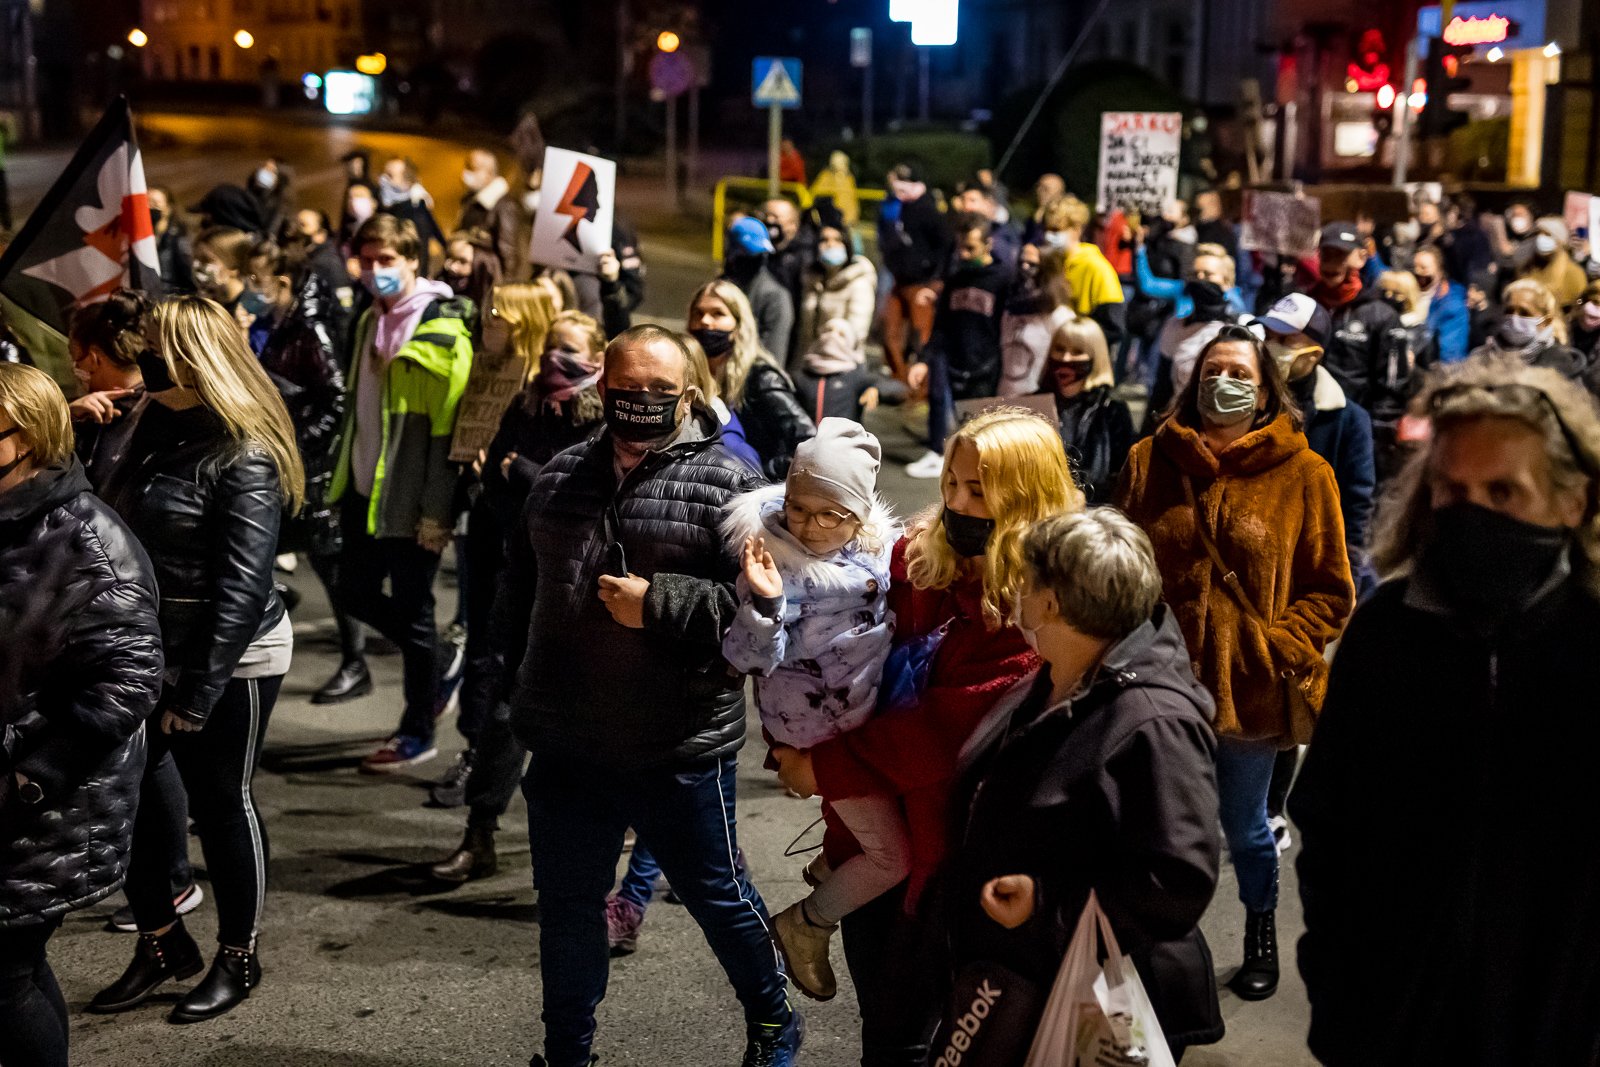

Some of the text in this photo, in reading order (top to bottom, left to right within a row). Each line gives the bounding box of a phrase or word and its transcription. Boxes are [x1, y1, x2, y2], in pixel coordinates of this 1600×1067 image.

[615, 399, 631, 410] KTO
[632, 403, 645, 413] NIE
[614, 410, 663, 424] TEN ROZNOSI
